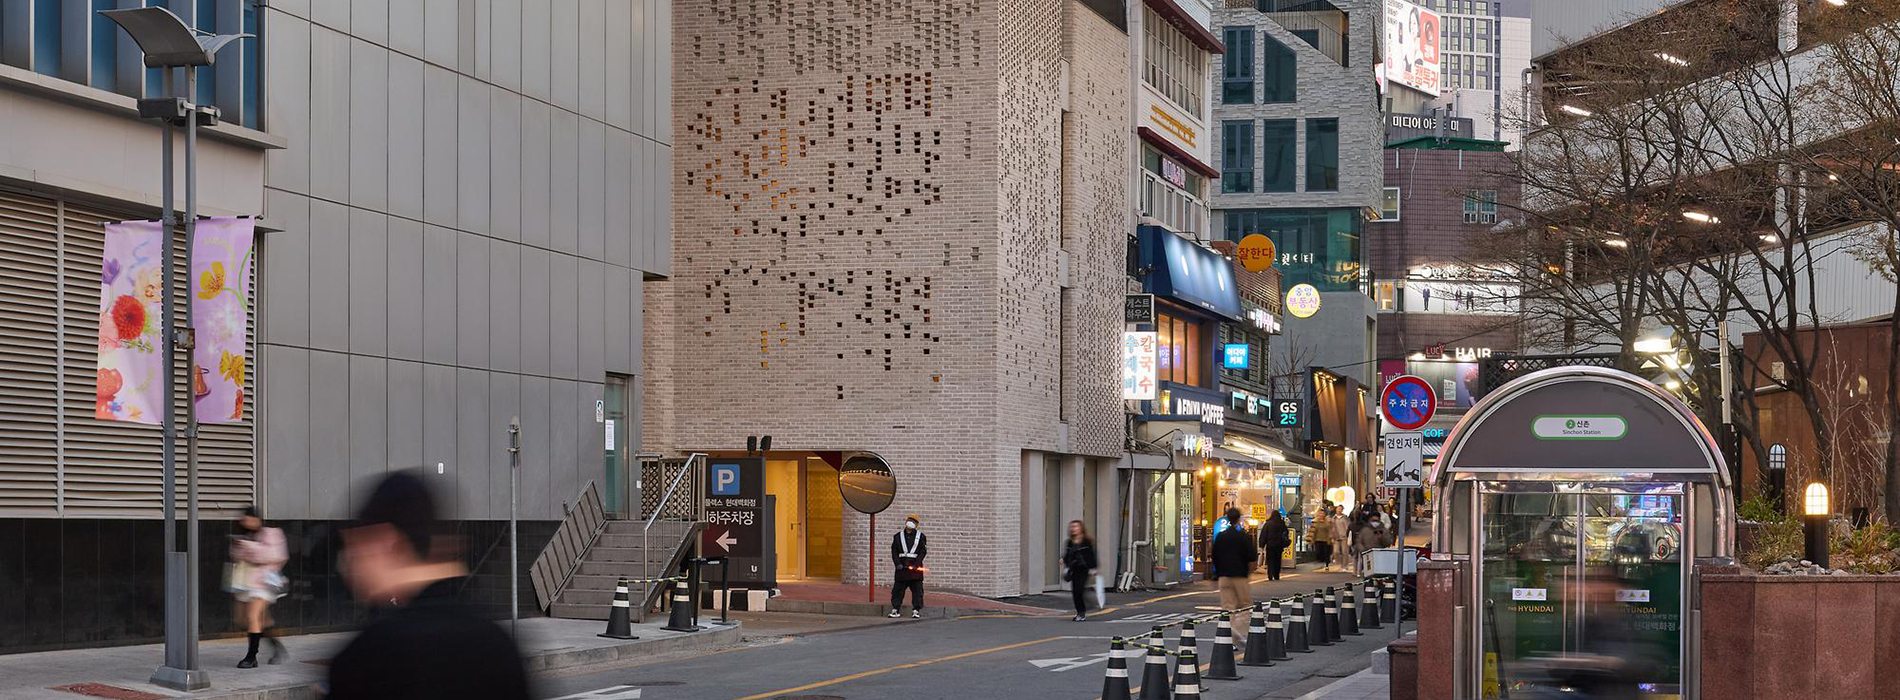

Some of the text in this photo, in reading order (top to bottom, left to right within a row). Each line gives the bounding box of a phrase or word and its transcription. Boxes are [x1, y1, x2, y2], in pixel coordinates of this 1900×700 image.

[1393, 116, 1459, 131] 미디어 아미
[1238, 246, 1273, 260] 잘한다
[1295, 287, 1313, 297] 중앙
[1126, 298, 1150, 308] 게스트
[1288, 297, 1318, 309] 부동산
[1126, 309, 1150, 319] 하우스
[1456, 347, 1491, 359] HAIR
[1125, 335, 1140, 394] 수제비
[1139, 335, 1155, 394] 칼국수
[1280, 402, 1297, 413] GS
[1201, 402, 1225, 426] COFFEE
[1280, 413, 1297, 425] 25
[1576, 420, 1590, 428] 신촌
[1387, 438, 1420, 449] 견인지역
[717, 469, 735, 492] P
[1517, 604, 1555, 613] HYUNDAI
